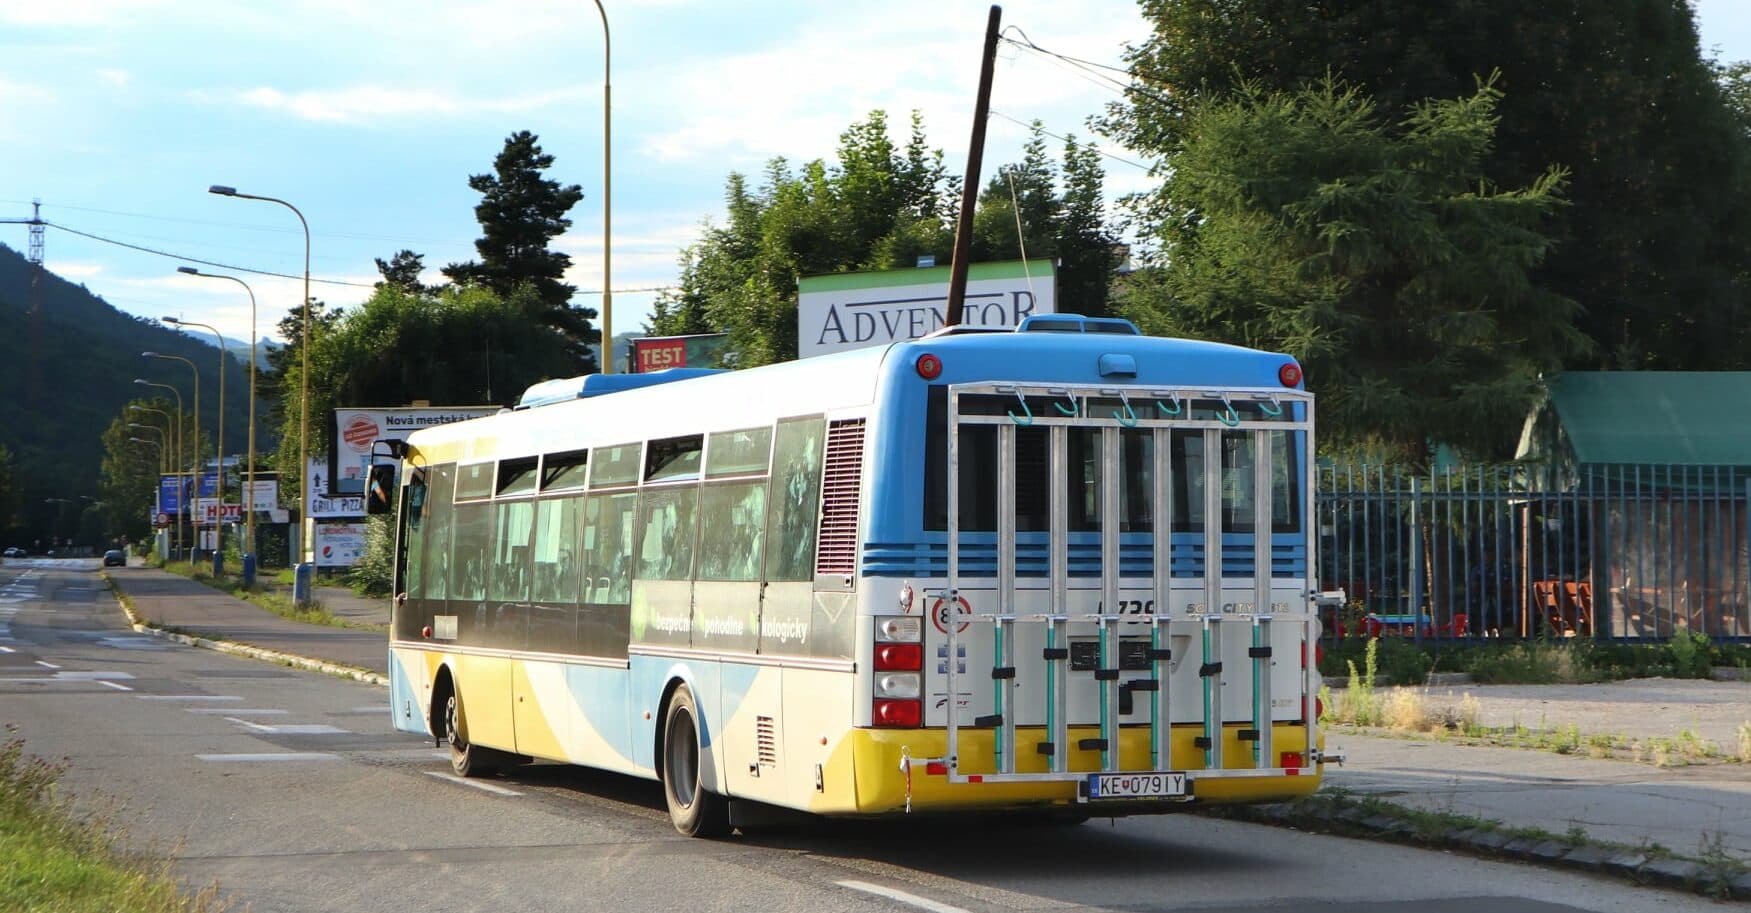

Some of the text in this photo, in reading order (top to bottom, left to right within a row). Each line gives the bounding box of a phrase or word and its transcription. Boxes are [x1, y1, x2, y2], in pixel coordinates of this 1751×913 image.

[641, 347, 682, 364] TEST
[386, 414, 414, 426] Nová
[416, 413, 464, 425] mestská
